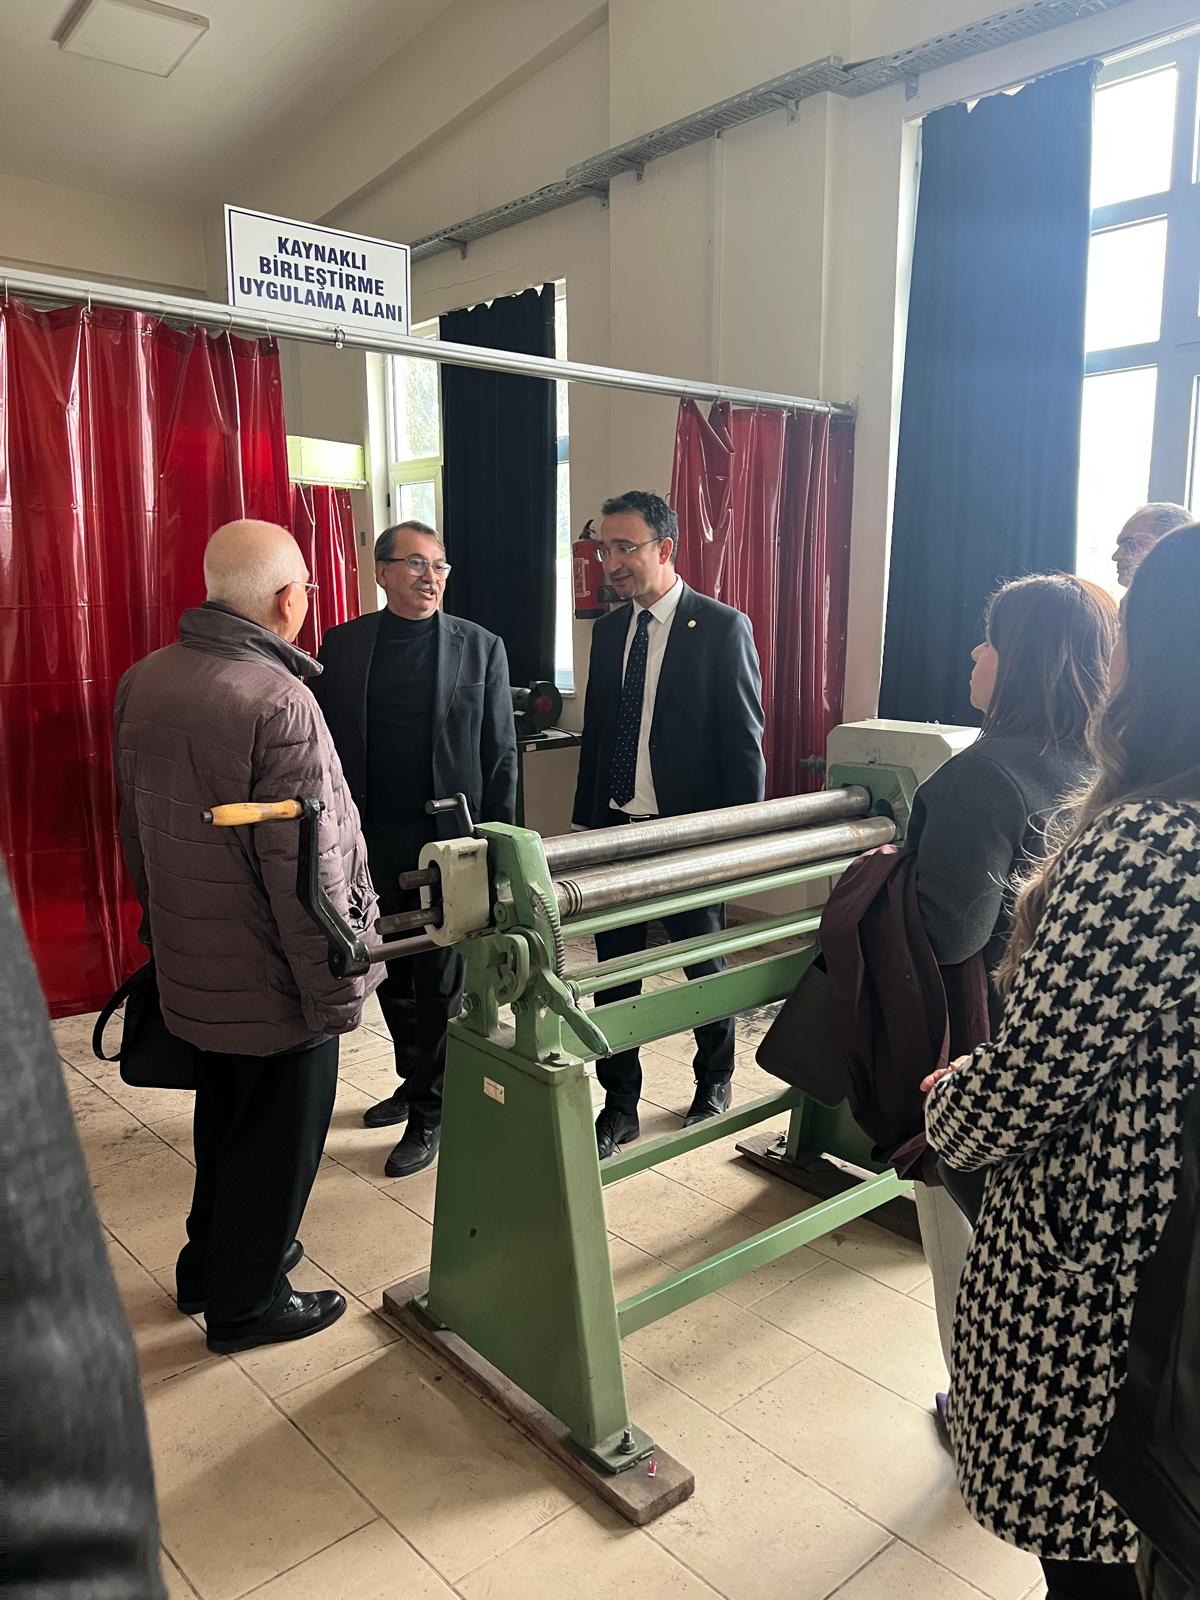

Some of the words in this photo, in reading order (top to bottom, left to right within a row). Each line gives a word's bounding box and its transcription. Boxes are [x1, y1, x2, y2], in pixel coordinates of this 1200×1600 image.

[278, 236, 366, 270] KAYNAKLI
[259, 255, 384, 296] BİRLEŞTİRME
[239, 276, 346, 312] UYGULAMA
[352, 298, 402, 322] ALANI
